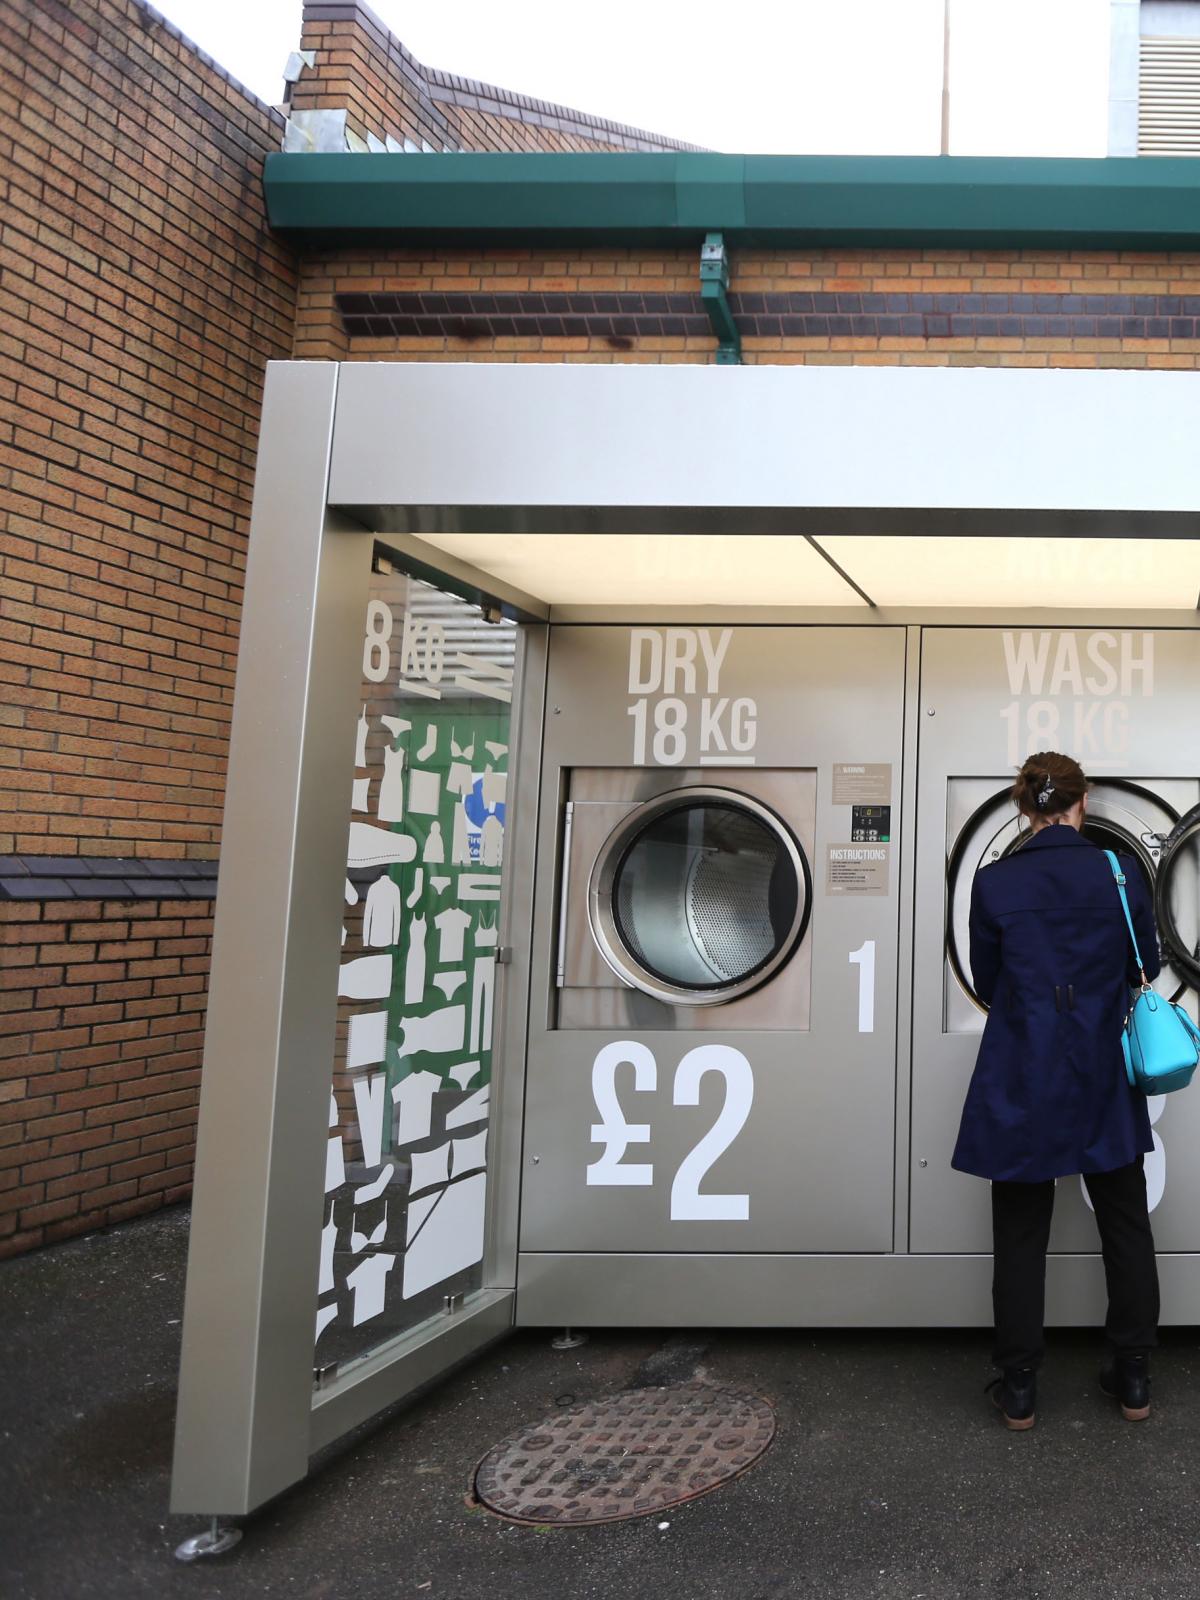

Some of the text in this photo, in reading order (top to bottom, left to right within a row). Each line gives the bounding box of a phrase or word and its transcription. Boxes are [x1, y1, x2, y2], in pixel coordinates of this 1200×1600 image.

[628, 628, 734, 695] DRY
[1002, 632, 1155, 697] WASH
[627, 697, 757, 766] 18 KG
[1000, 701, 1129, 767] 18 KG
[830, 849, 886, 861] INSTRUCTIONS
[848, 940, 876, 1033] 1
[586, 1040, 755, 1221] £2
